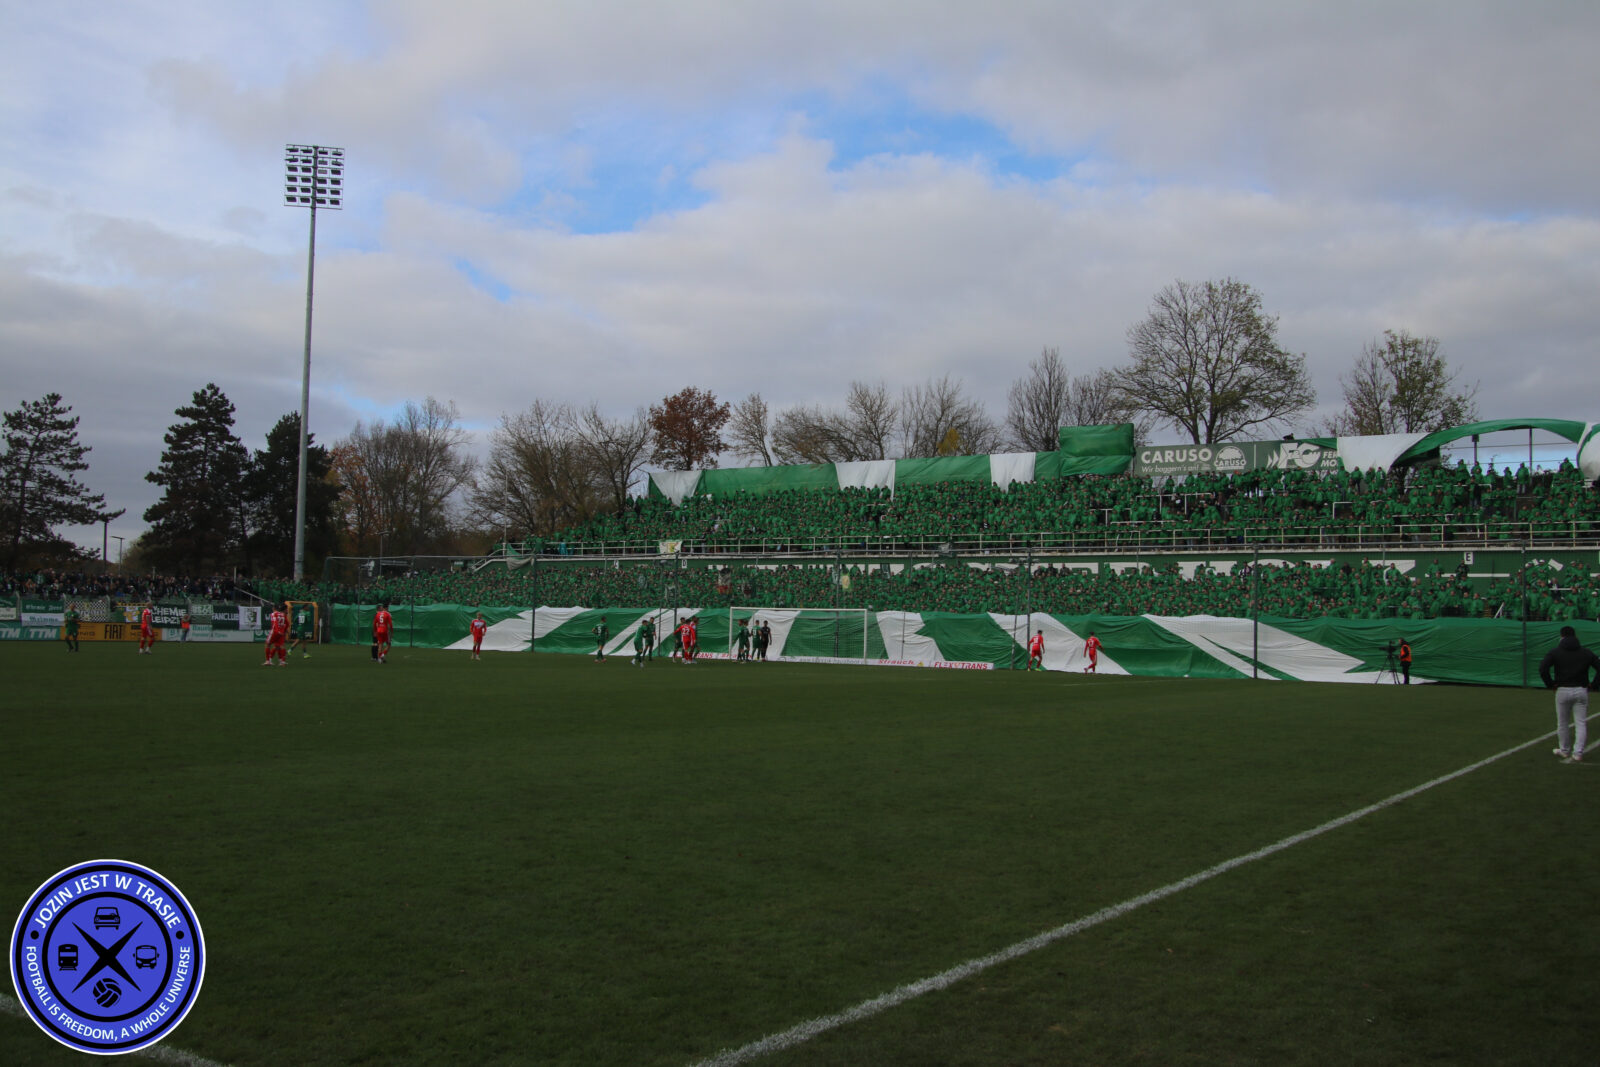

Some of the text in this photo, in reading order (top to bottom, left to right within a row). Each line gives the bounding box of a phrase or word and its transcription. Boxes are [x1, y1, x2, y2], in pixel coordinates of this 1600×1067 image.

[1141, 448, 1212, 464] CARUSO
[1213, 459, 1247, 467] CARUSO
[1141, 465, 1154, 473] Wir
[151, 606, 187, 617] CHEMIE
[29, 628, 58, 639] TTM
[104, 623, 123, 640] FIAT
